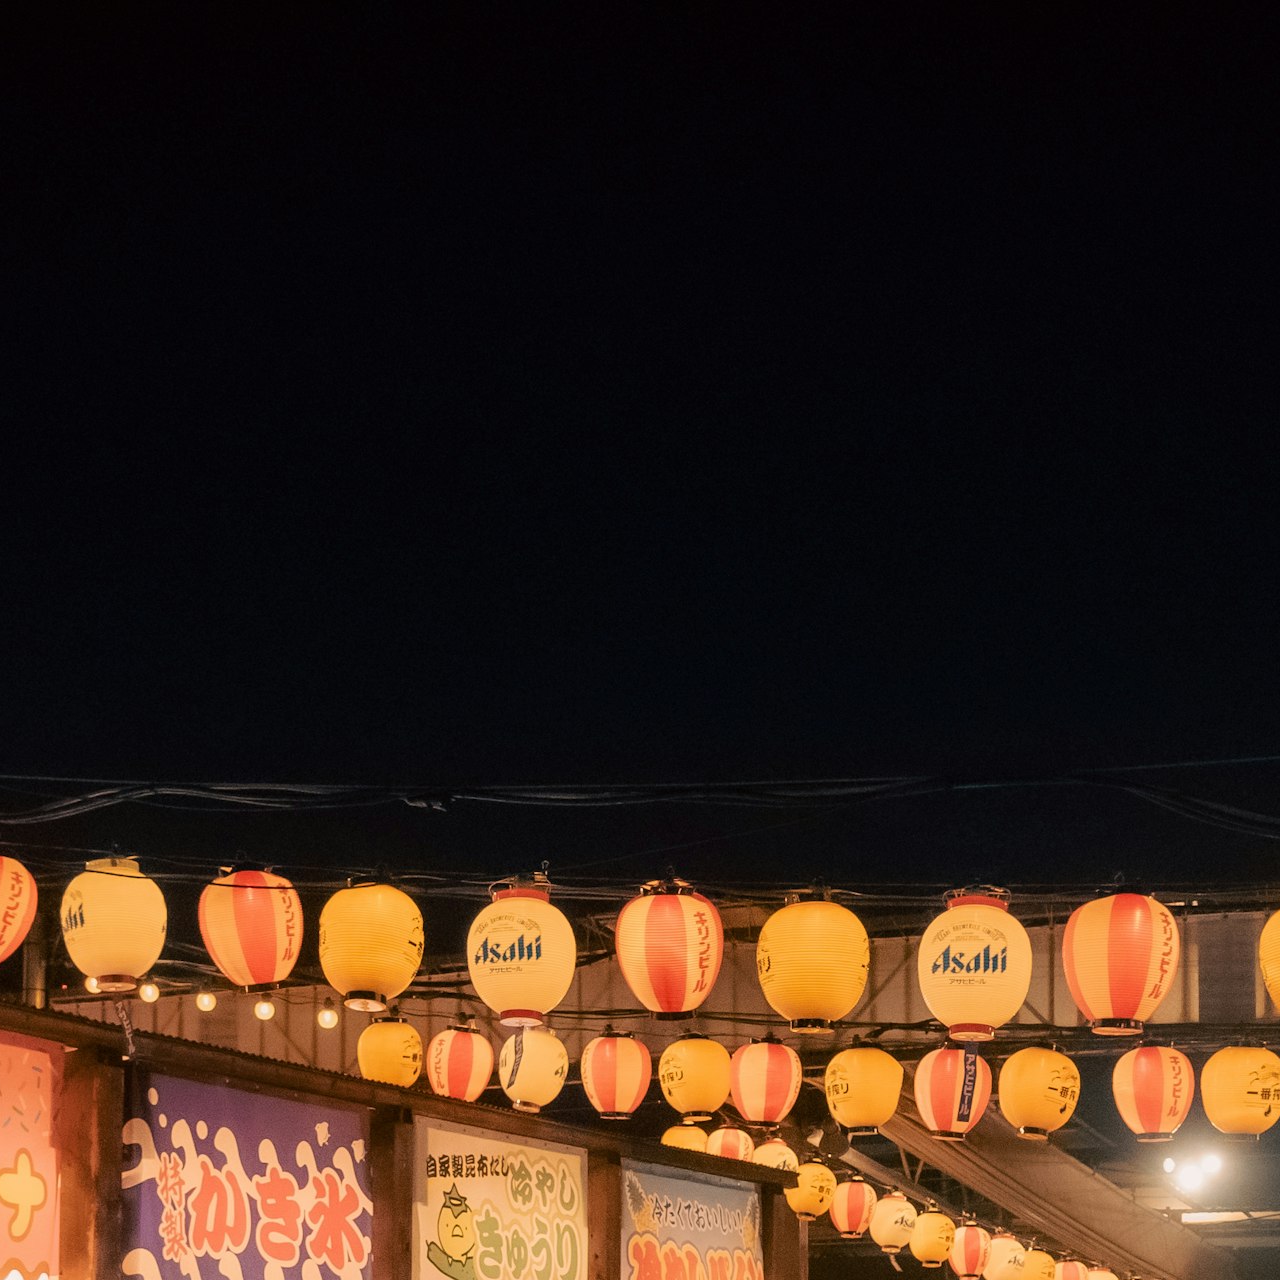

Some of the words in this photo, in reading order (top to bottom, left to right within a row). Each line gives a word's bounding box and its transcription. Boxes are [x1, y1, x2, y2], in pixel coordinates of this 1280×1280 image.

[277, 883, 295, 961] キリンビール
[475, 934, 542, 966] Asahi
[693, 911, 711, 993] キリンビール
[931, 945, 1008, 975] Asahi
[949, 978, 987, 986] アサヒビール
[1148, 911, 1173, 1000] キリンビール
[959, 1053, 976, 1115] アサヒビール
[1167, 1055, 1183, 1118] キリンビール
[425, 1154, 509, 1178] 自家製昆布だし
[508, 1157, 577, 1212] 冷やし
[159, 1153, 188, 1261] 特製
[190, 1157, 367, 1273] かき氷
